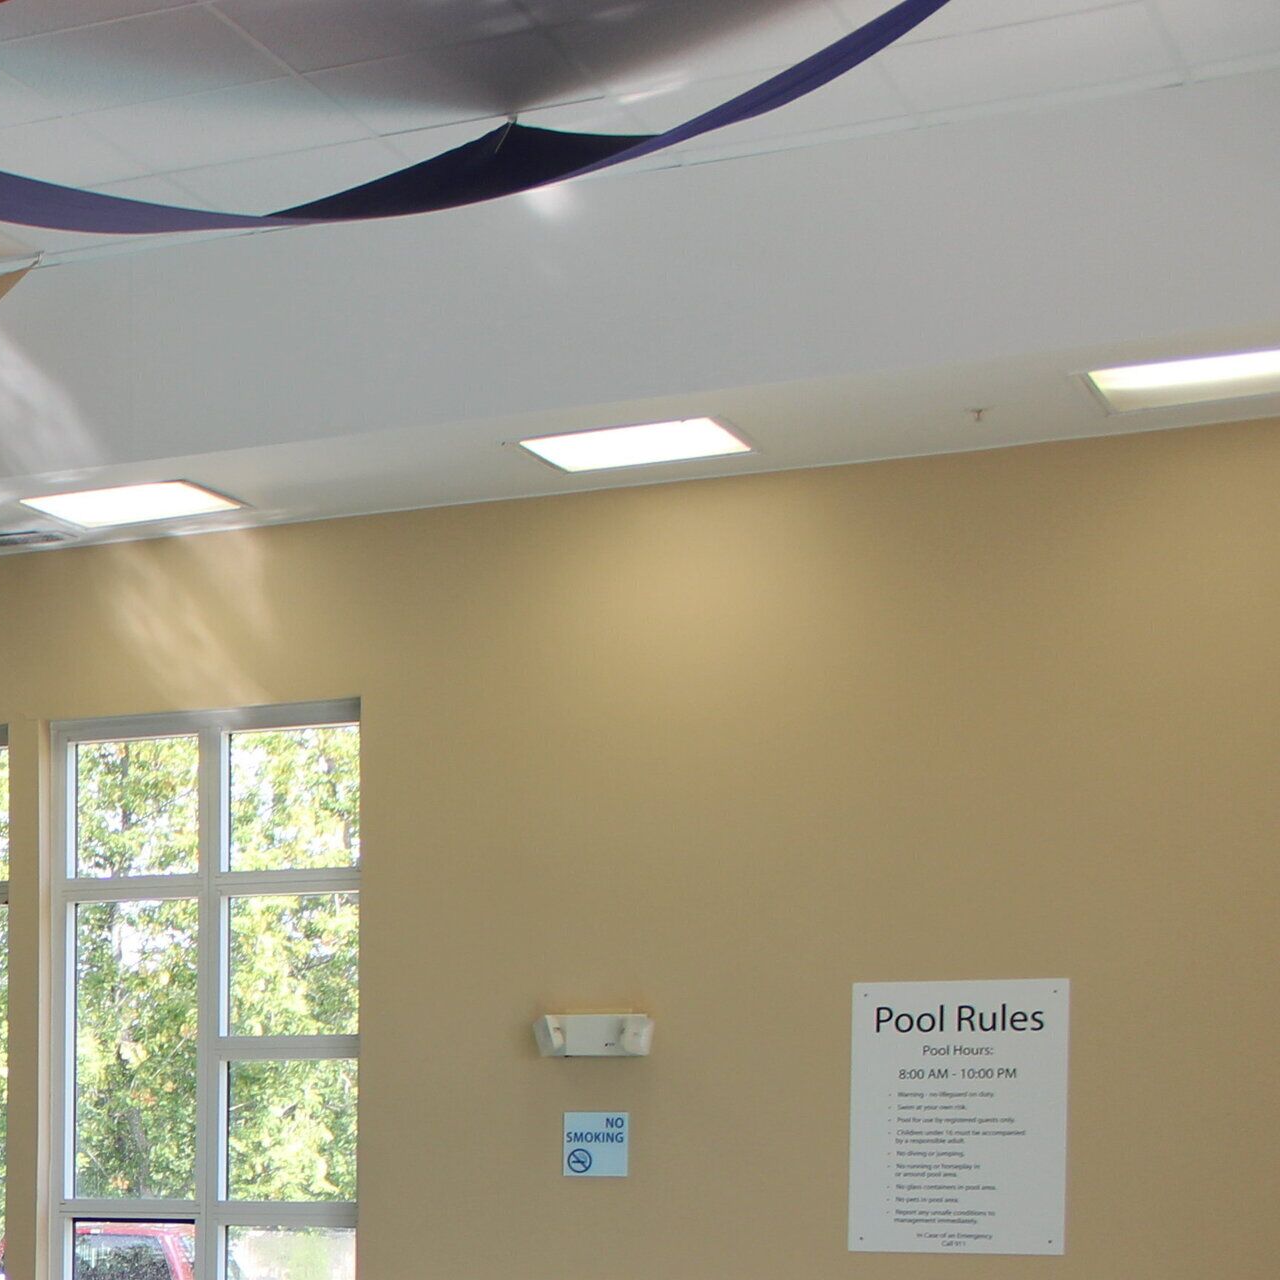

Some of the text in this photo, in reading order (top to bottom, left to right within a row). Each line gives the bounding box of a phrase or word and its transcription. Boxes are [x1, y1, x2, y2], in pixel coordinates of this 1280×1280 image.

[875, 1003, 1045, 1033] Pool Rules
[922, 1045, 994, 1056] Pool Hours:
[898, 1069, 925, 1080] 8:00
[928, 1069, 948, 1079] AM
[961, 1068, 994, 1080] 10:00
[997, 1068, 1017, 1079] PM
[606, 1117, 624, 1128] NO
[566, 1131, 624, 1143] SMOKING
